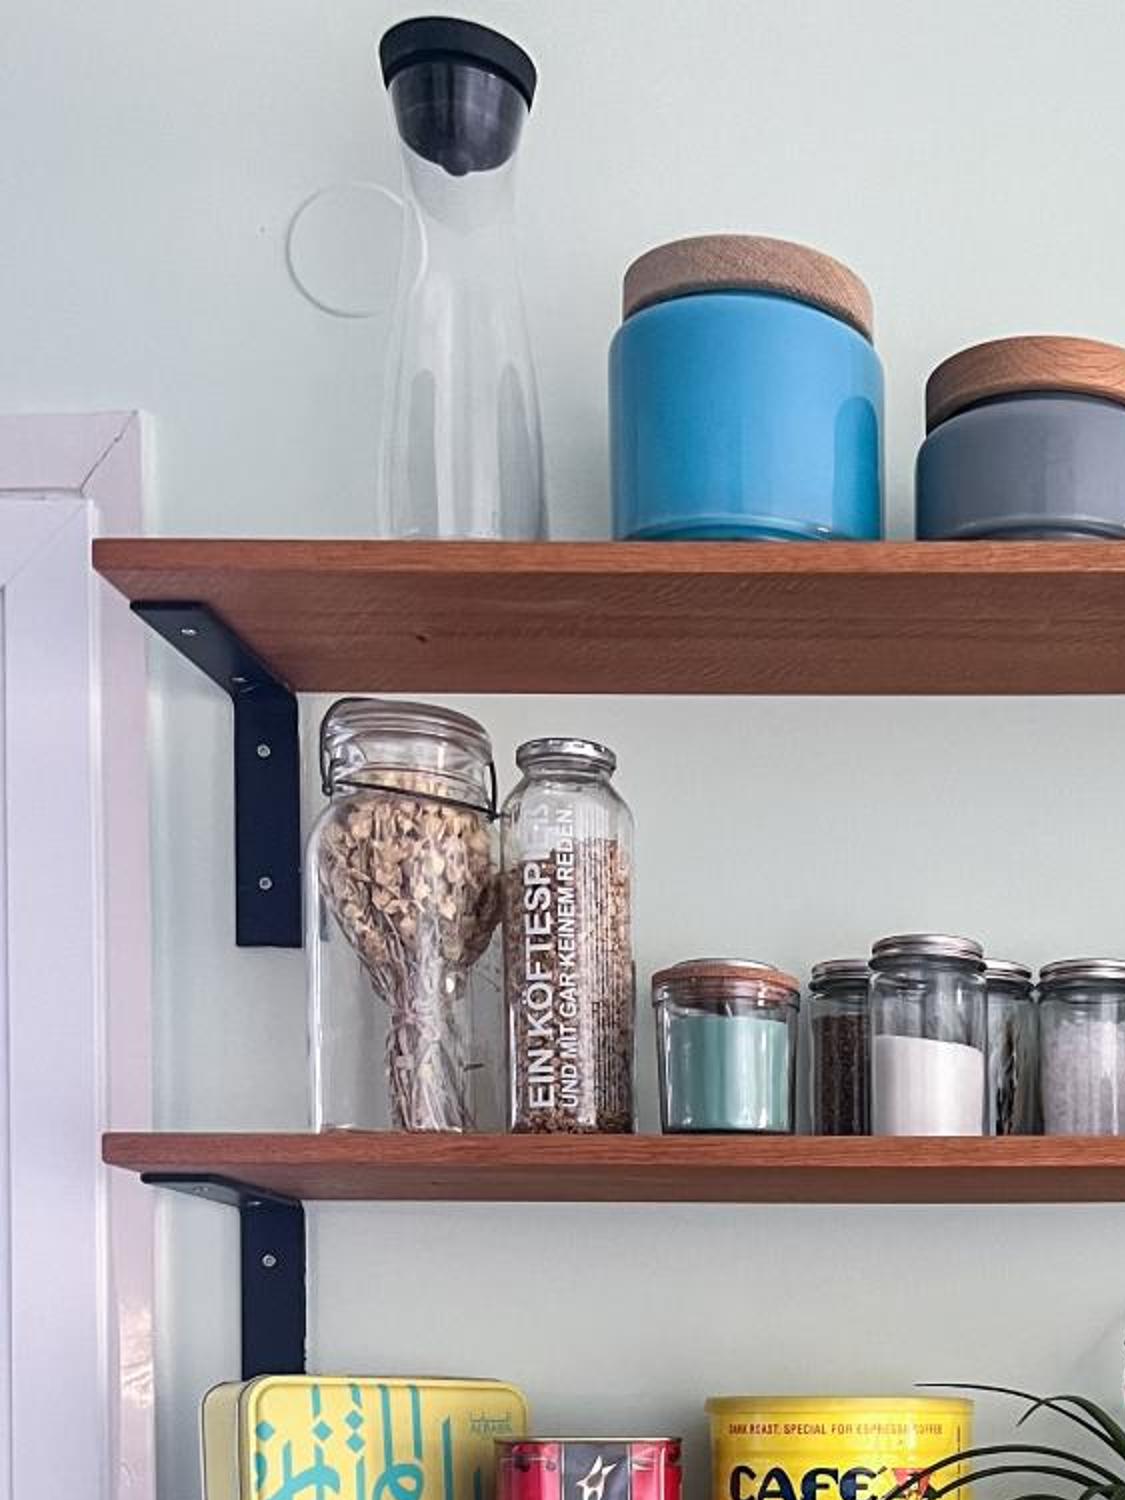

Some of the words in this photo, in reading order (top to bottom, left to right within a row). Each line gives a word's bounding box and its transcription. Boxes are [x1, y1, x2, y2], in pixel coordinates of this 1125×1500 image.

[556, 886, 576, 967] KEINEM
[558, 972, 577, 1017] GAR
[559, 1025, 577, 1058] MIT
[526, 1047, 556, 1108] EIN
[559, 1063, 578, 1108] UND
